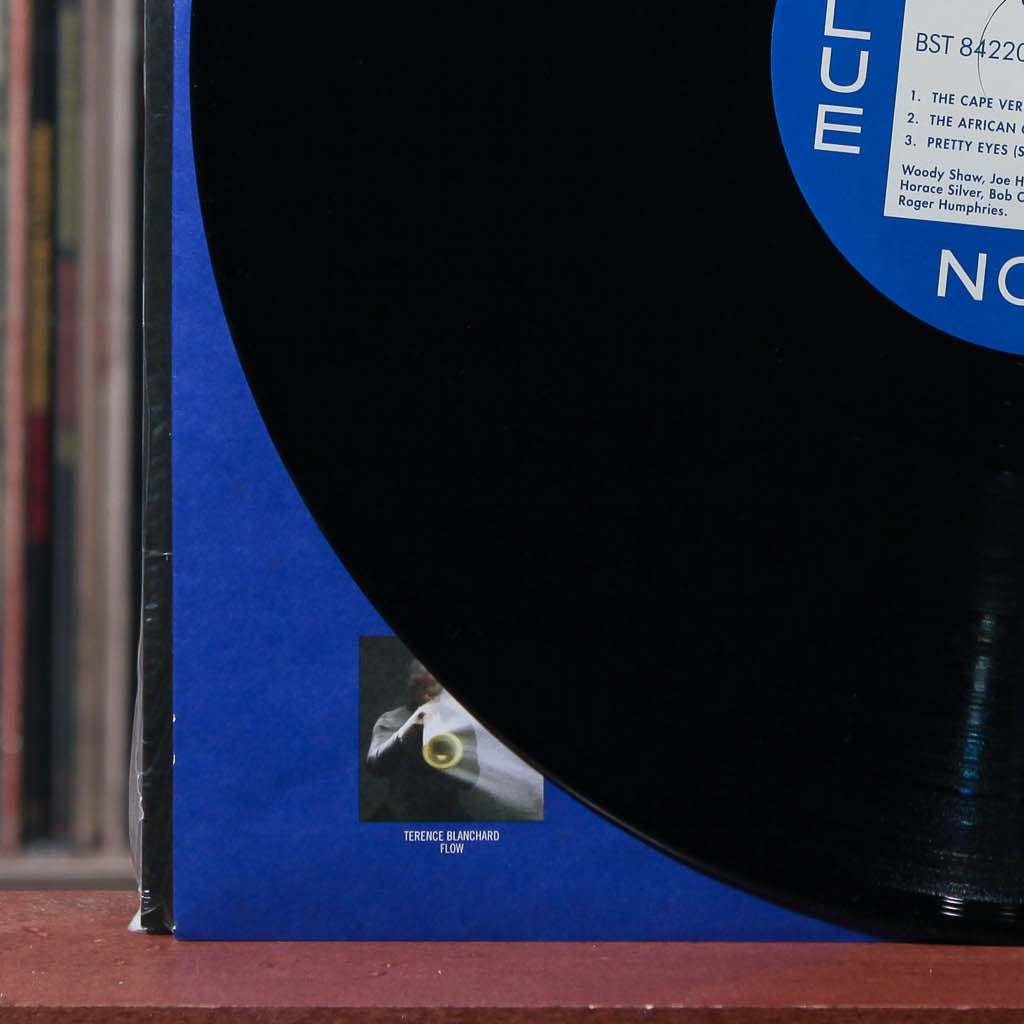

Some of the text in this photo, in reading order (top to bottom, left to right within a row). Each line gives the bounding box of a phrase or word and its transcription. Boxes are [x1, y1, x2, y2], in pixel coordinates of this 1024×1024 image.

[915, 32, 954, 55] BST
[911, 90, 921, 102] 1.
[932, 92, 955, 105] THE
[961, 95, 993, 109] CAPE
[907, 113, 919, 125] 2.
[930, 114, 953, 127] THE
[957, 117, 1016, 134] AFRICAN
[904, 135, 916, 147] 3.
[927, 137, 973, 152] PRETTY
[978, 142, 1008, 156] EYES
[902, 164, 945, 182] Woody
[949, 169, 986, 185] Shaw,
[990, 173, 1011, 186] Joe
[900, 180, 943, 195] Horace
[948, 185, 984, 200] Silver,
[989, 189, 1012, 202] Bob
[899, 195, 1008, 218] Roger Humphries.
[403, 830, 500, 842] TERENCE BLANCHARD
[440, 843, 465, 854] FLOW
